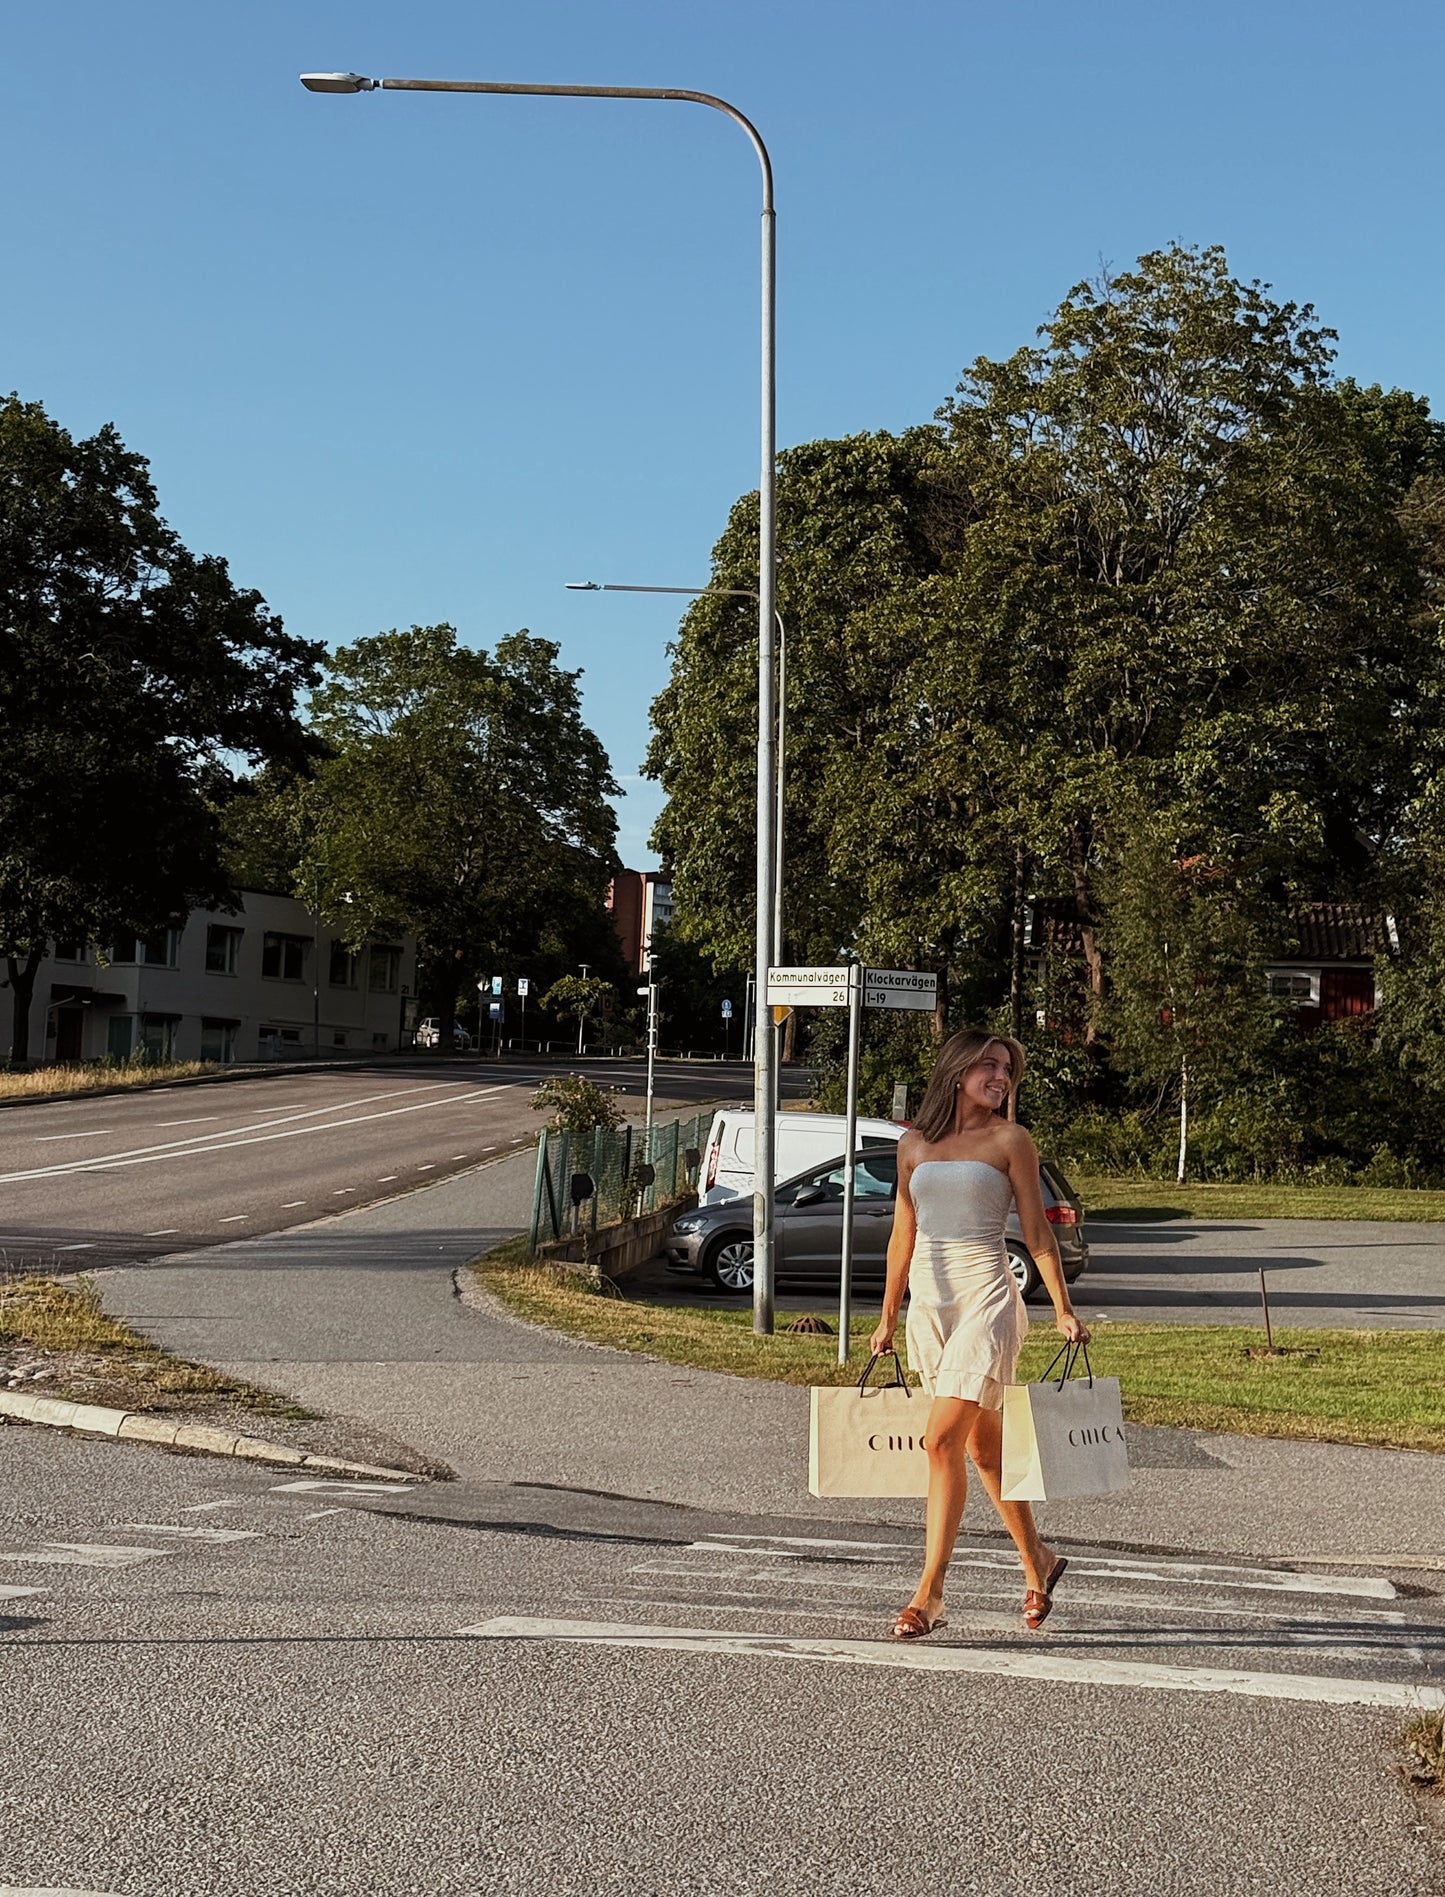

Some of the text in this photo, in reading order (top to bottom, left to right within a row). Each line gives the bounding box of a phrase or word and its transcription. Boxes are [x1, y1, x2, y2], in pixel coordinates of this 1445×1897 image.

[770, 971, 846, 984] Kommunalvägen
[867, 973, 936, 989] Klockarvägen
[832, 991, 845, 1002] 26
[867, 993, 886, 1004] 1-19
